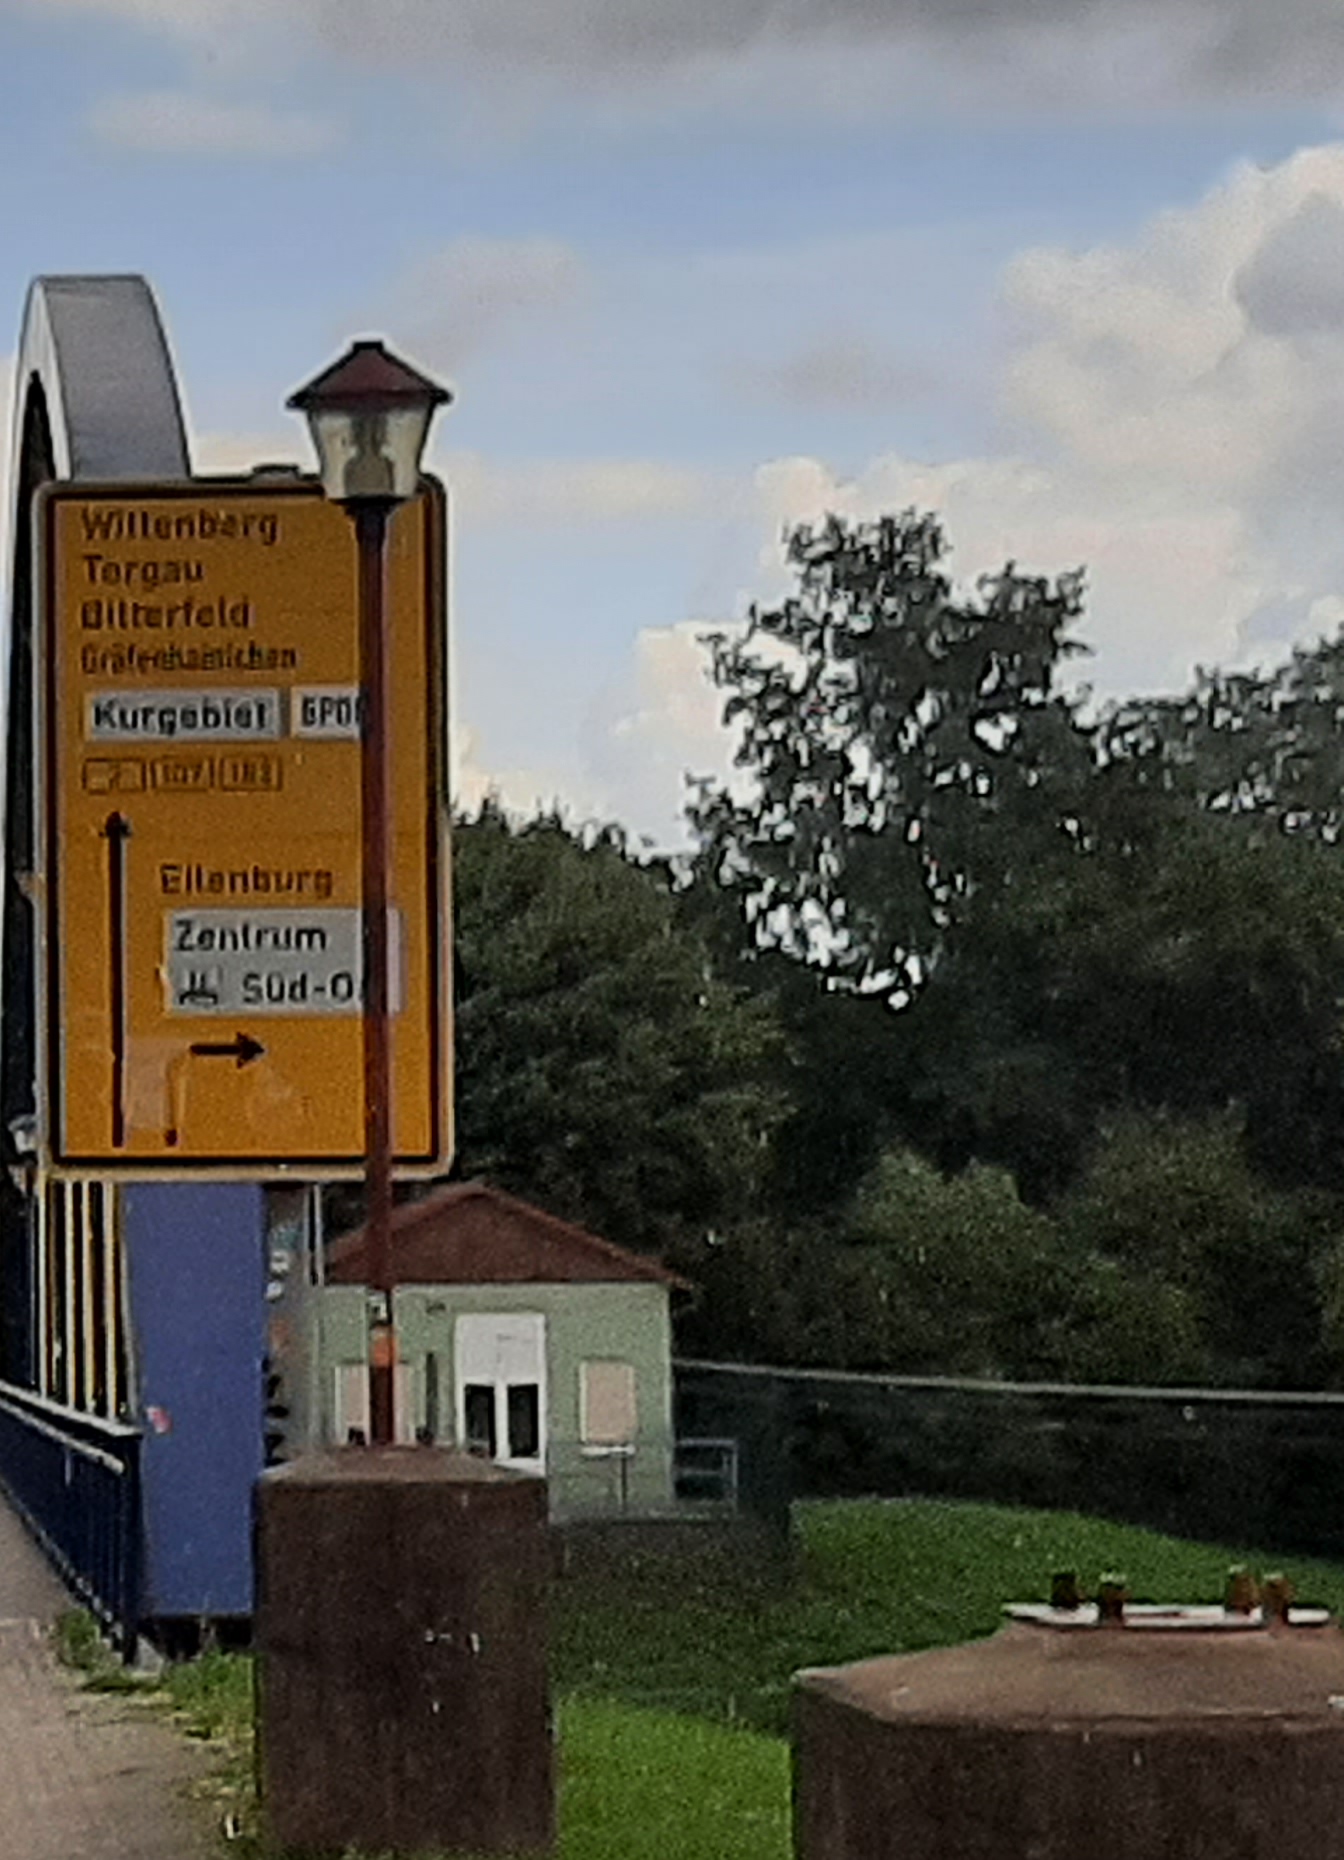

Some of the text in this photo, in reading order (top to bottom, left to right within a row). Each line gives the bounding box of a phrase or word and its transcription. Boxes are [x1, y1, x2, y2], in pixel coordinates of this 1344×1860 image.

[82, 554, 203, 591] Torgau
[82, 596, 250, 630] Bitterfeld
[93, 696, 267, 737] Kurgebiet
[160, 863, 333, 899] Eilenburg
[174, 919, 327, 952] Zentrum
[242, 972, 361, 1004] Süd-O
